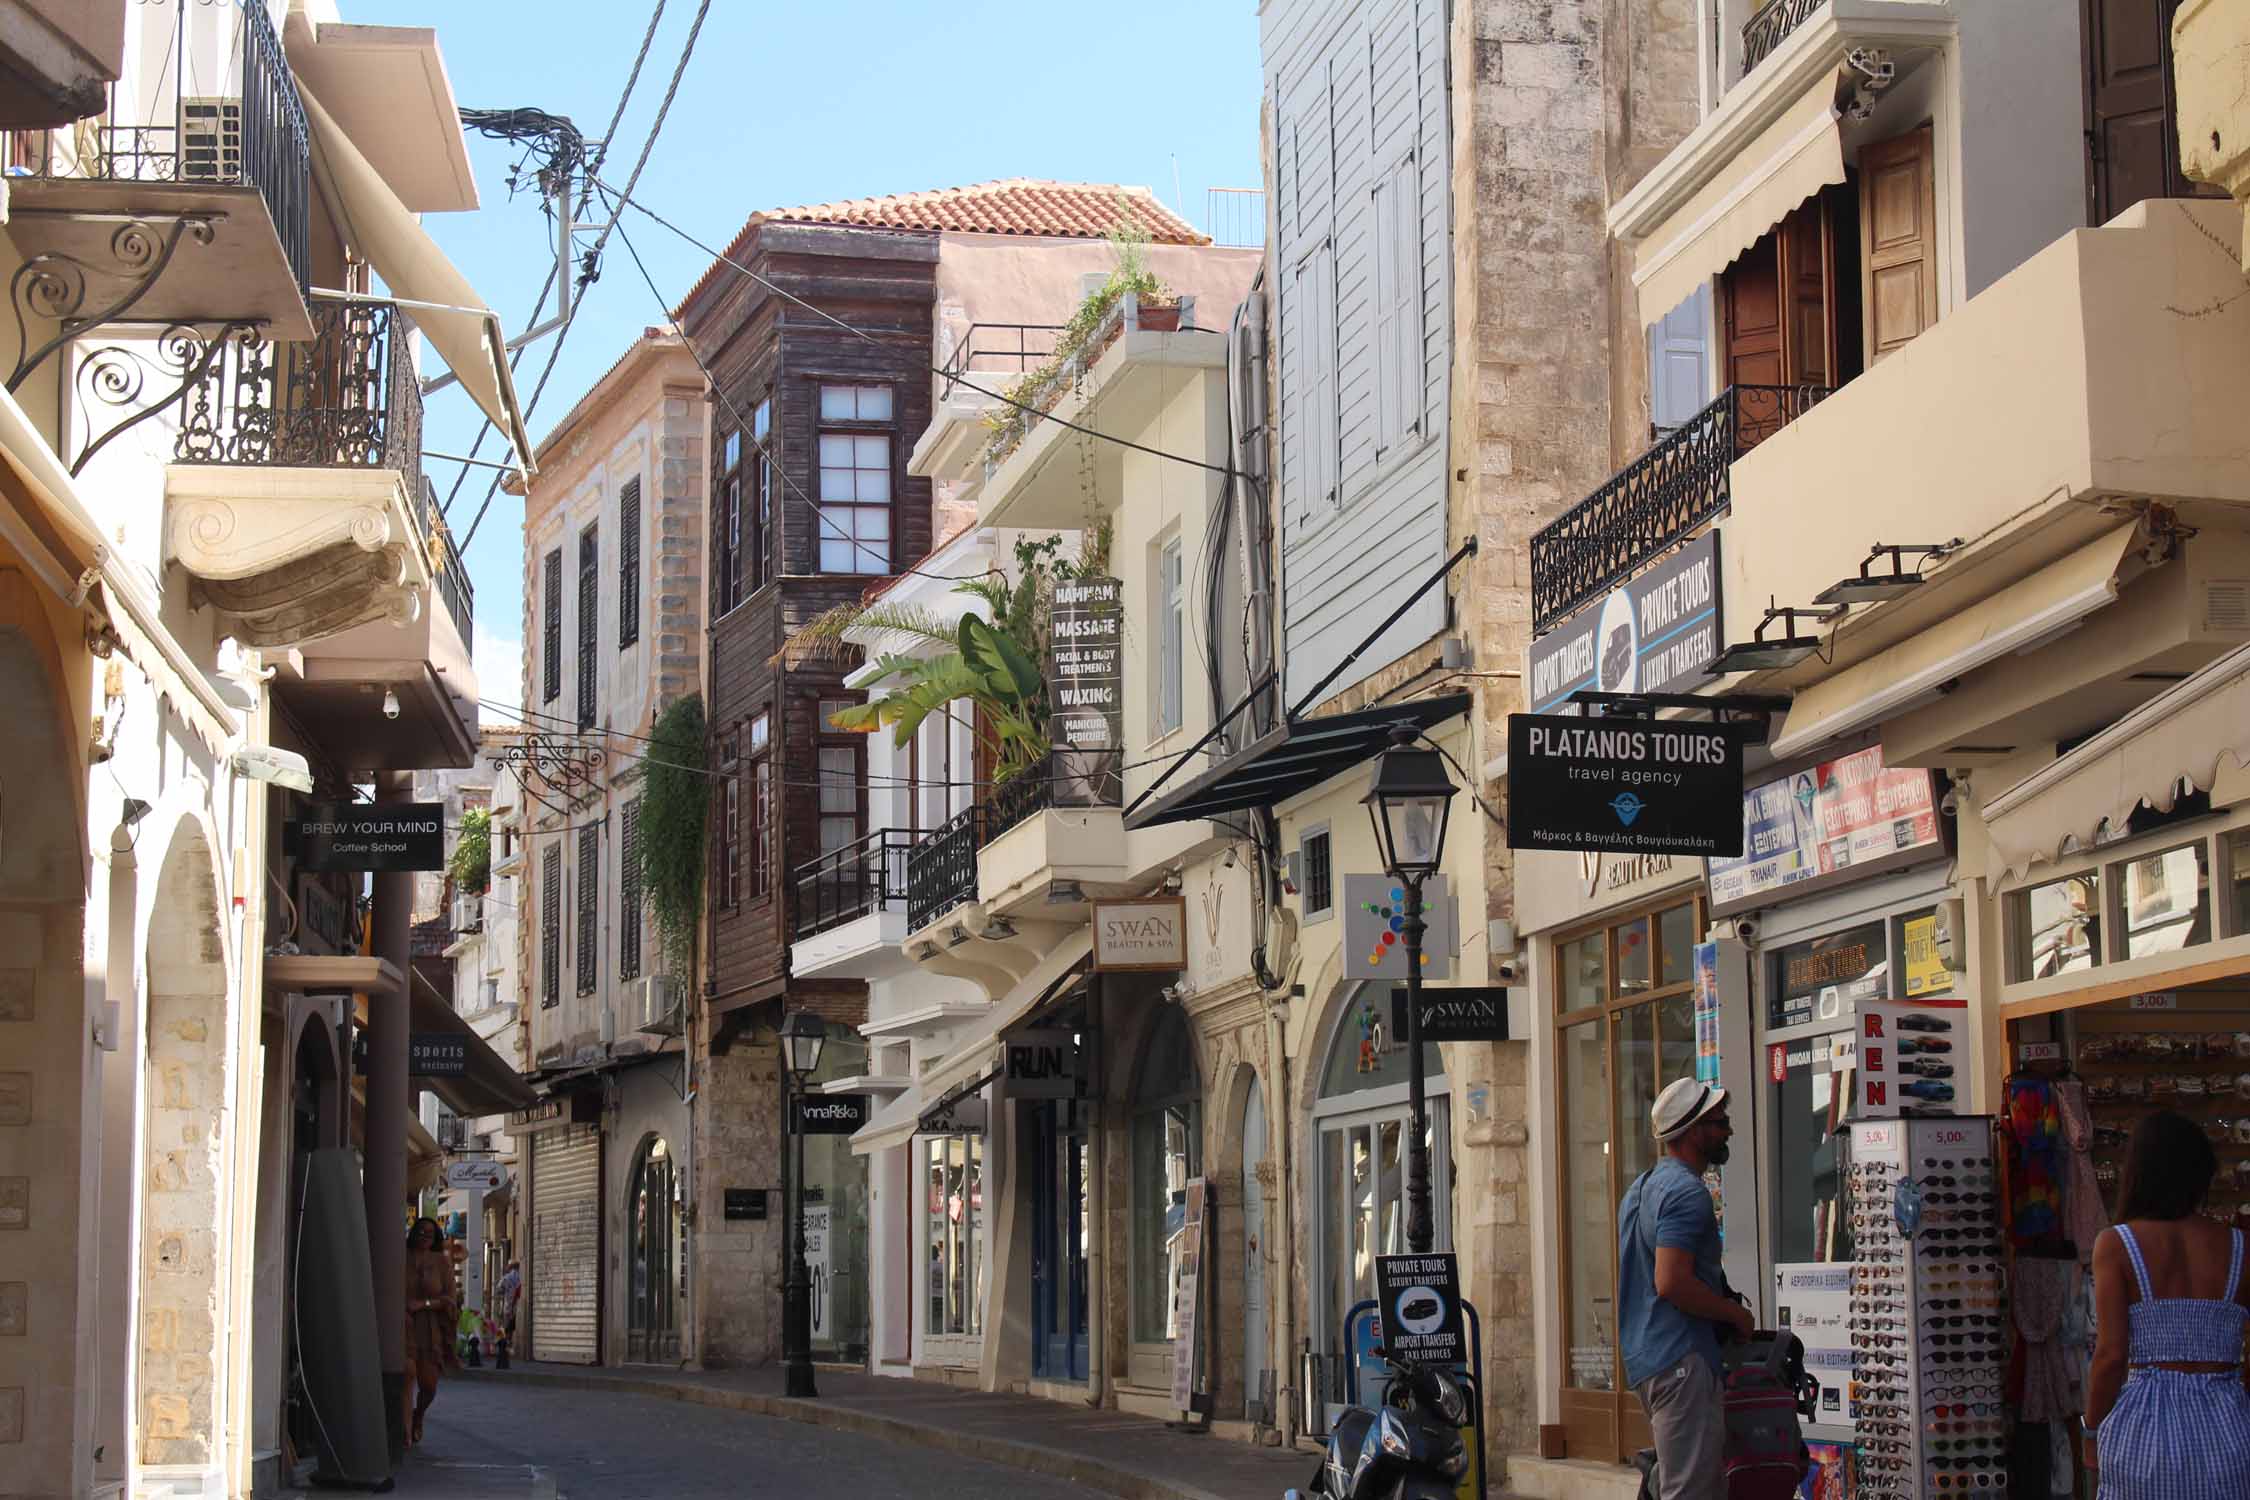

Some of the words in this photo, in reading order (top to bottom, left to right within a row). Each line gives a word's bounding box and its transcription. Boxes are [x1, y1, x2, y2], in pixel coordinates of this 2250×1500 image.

[1640, 576, 1677, 639] PRIVATE
[1678, 556, 1710, 614] TOURS
[1056, 652, 1082, 664] FACIAL
[1084, 650, 1090, 661] &
[1092, 650, 1115, 660] BODY
[1642, 652, 1670, 694] LUXURY
[1671, 624, 1712, 677] TRANSFERS
[1060, 662, 1112, 676] TREATMENTS
[1534, 650, 1559, 703] AIRPORT
[1559, 629, 1594, 684] TRANSFERS
[1060, 688, 1112, 706] WAXING
[1065, 718, 1108, 731] MANICURE
[1066, 730, 1106, 744] PEDICURE
[1529, 727, 1646, 761] PLATANOS
[1651, 732, 1726, 765] TOURS
[1568, 766, 1614, 781] travel
[1621, 770, 1682, 788] agency
[302, 823, 348, 834] BREW
[352, 822, 394, 834] YOUR
[397, 822, 438, 833] MIND
[1532, 830, 1572, 844] Μάρκος
[1574, 832, 1582, 842] &
[1585, 832, 1634, 846] Βαγγέλης
[332, 843, 368, 852] Coffee
[370, 842, 407, 852] School
[1605, 856, 1642, 890] BEAUTY
[1750, 863, 1777, 883] RYANAIR
[1107, 917, 1172, 938] SWAN
[1105, 940, 1144, 950] BEAUTY
[1157, 940, 1174, 949] SPA
[1437, 999, 1496, 1017] SWAN
[413, 1046, 464, 1058] sports
[1786, 1049, 1811, 1068] MINOAN
[1864, 1013, 1887, 1118] REN
[1386, 1260, 1420, 1274] PRIVATE
[1420, 1258, 1447, 1272] TOURS
[1388, 1276, 1413, 1288] LUXURY
[1414, 1274, 1448, 1286] TRANSFERS
[1394, 1334, 1421, 1348] AIRPORT
[1422, 1332, 1456, 1347] TRANSFERS
[1404, 1350, 1420, 1361] TAXI
[1421, 1348, 1452, 1360] SERVICES
